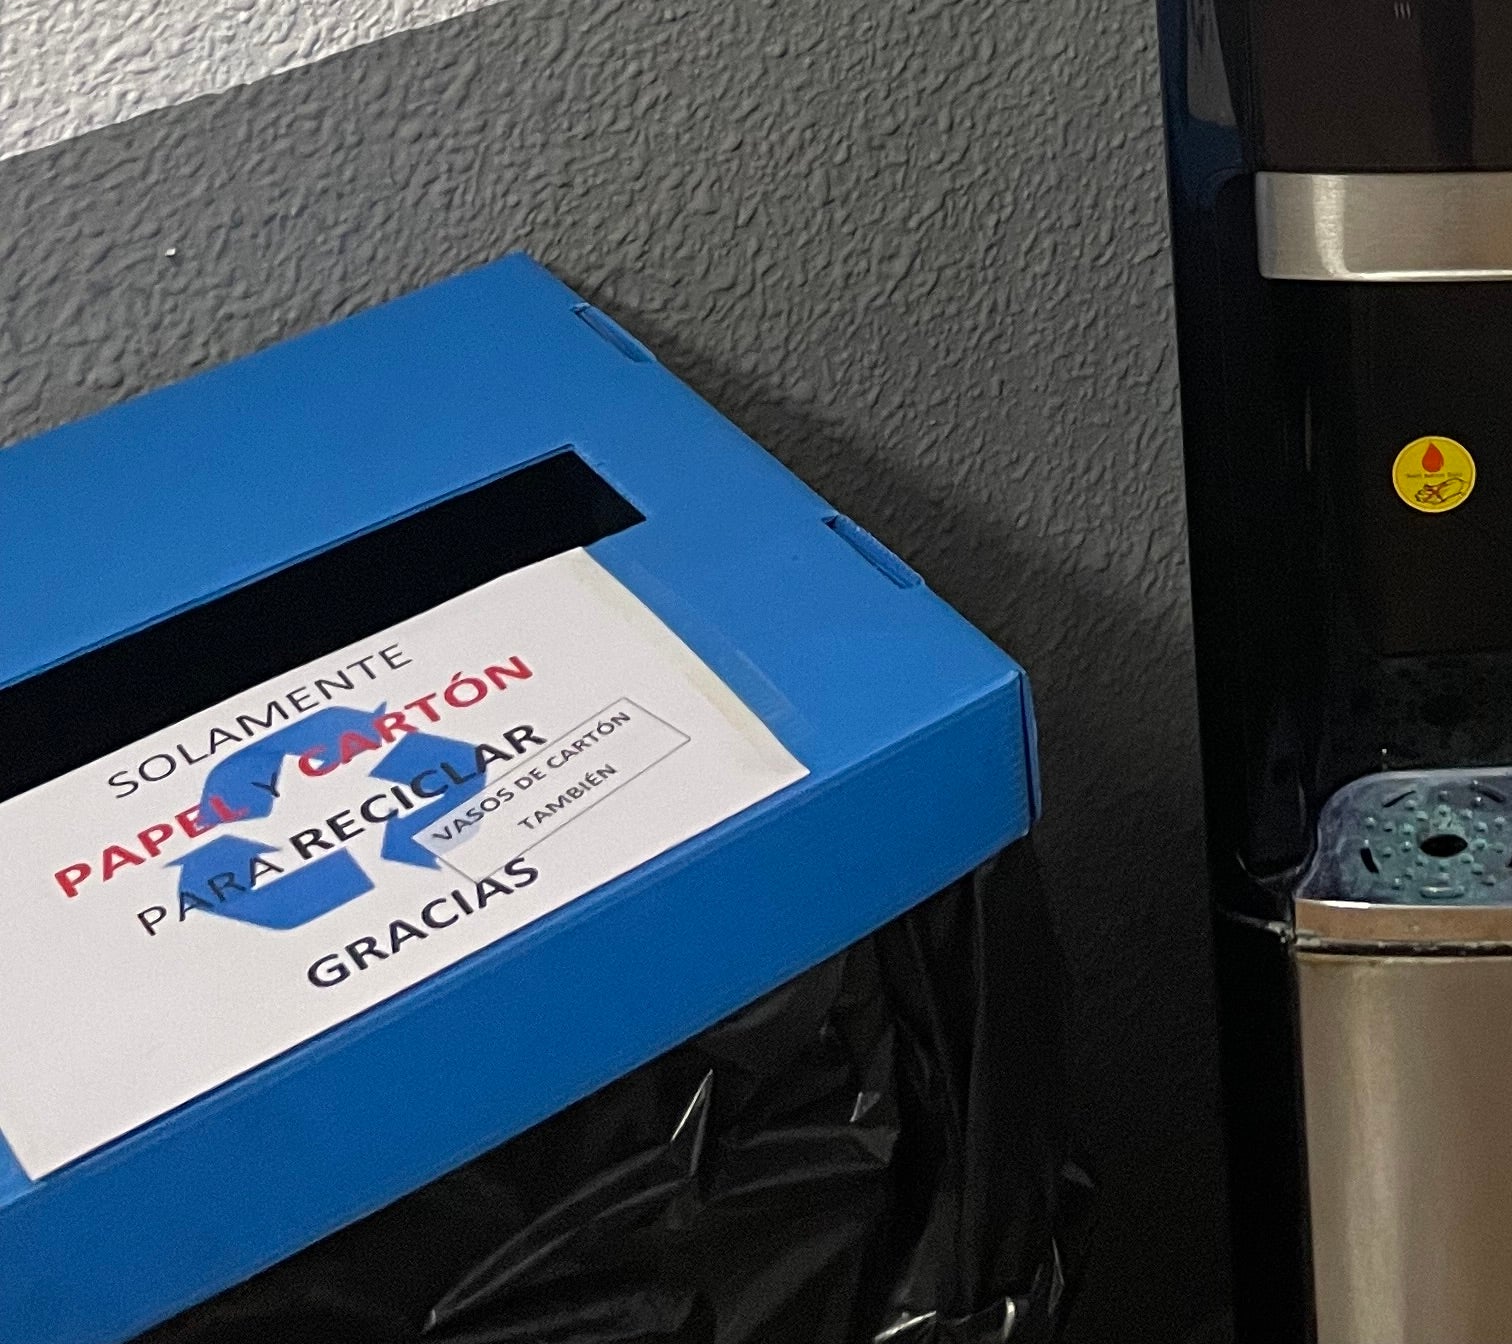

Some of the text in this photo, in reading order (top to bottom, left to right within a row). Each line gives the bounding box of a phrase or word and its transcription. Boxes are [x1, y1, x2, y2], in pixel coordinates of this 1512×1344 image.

[54, 655, 534, 897] PAPEL Y CARTÓN
[108, 643, 413, 799] SOLAMENTE
[432, 710, 632, 842] VASOS DE CARTÓN
[137, 723, 547, 936] PARA RECICLAR
[517, 762, 618, 831] TAMBIÉN
[307, 857, 539, 988] GRACIAS
